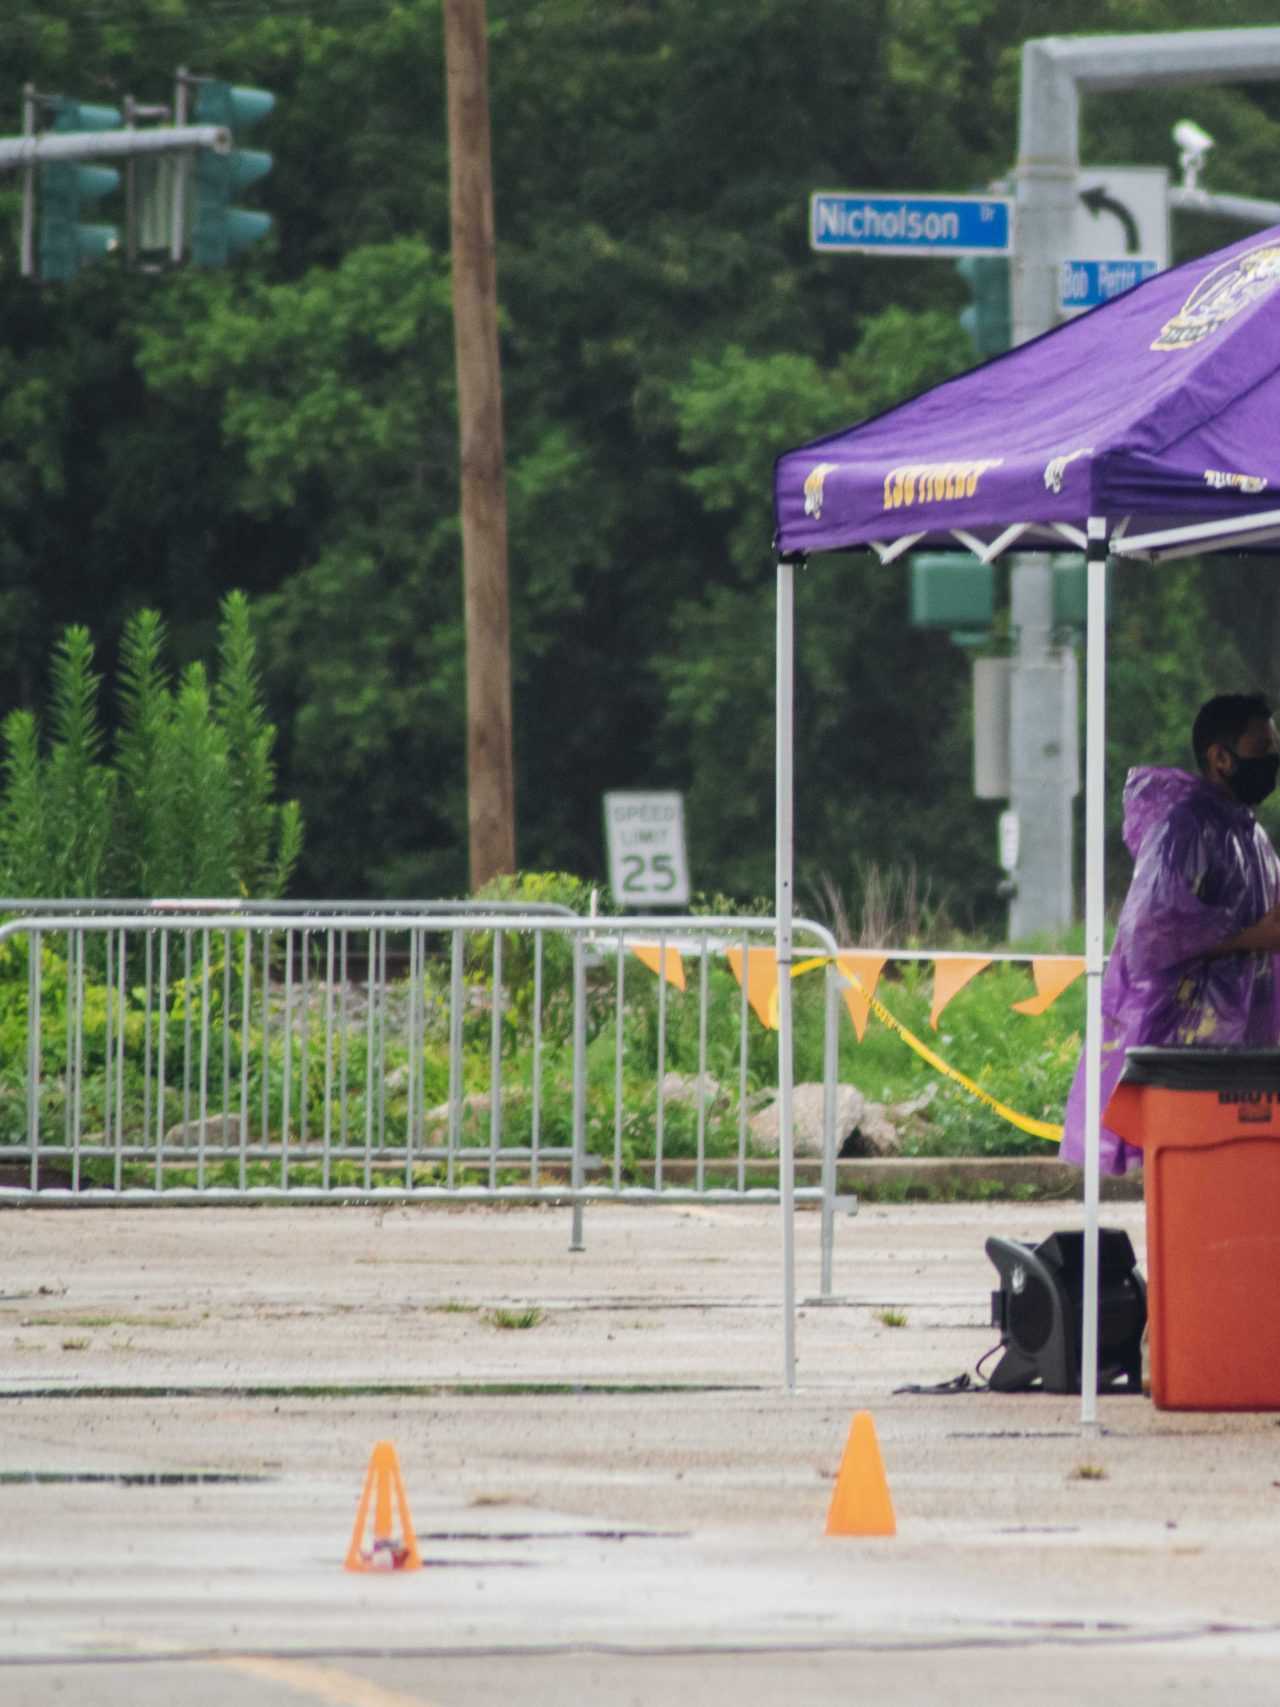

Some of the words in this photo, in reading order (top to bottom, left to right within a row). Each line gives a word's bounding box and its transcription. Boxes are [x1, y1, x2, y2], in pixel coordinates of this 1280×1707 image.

[817, 203, 958, 239] Nicholson
[980, 204, 996, 223] Dr
[1063, 263, 1089, 299] Bob
[614, 806, 674, 822] SPEED
[621, 830, 669, 845] LIMIT
[621, 853, 677, 892] 25
